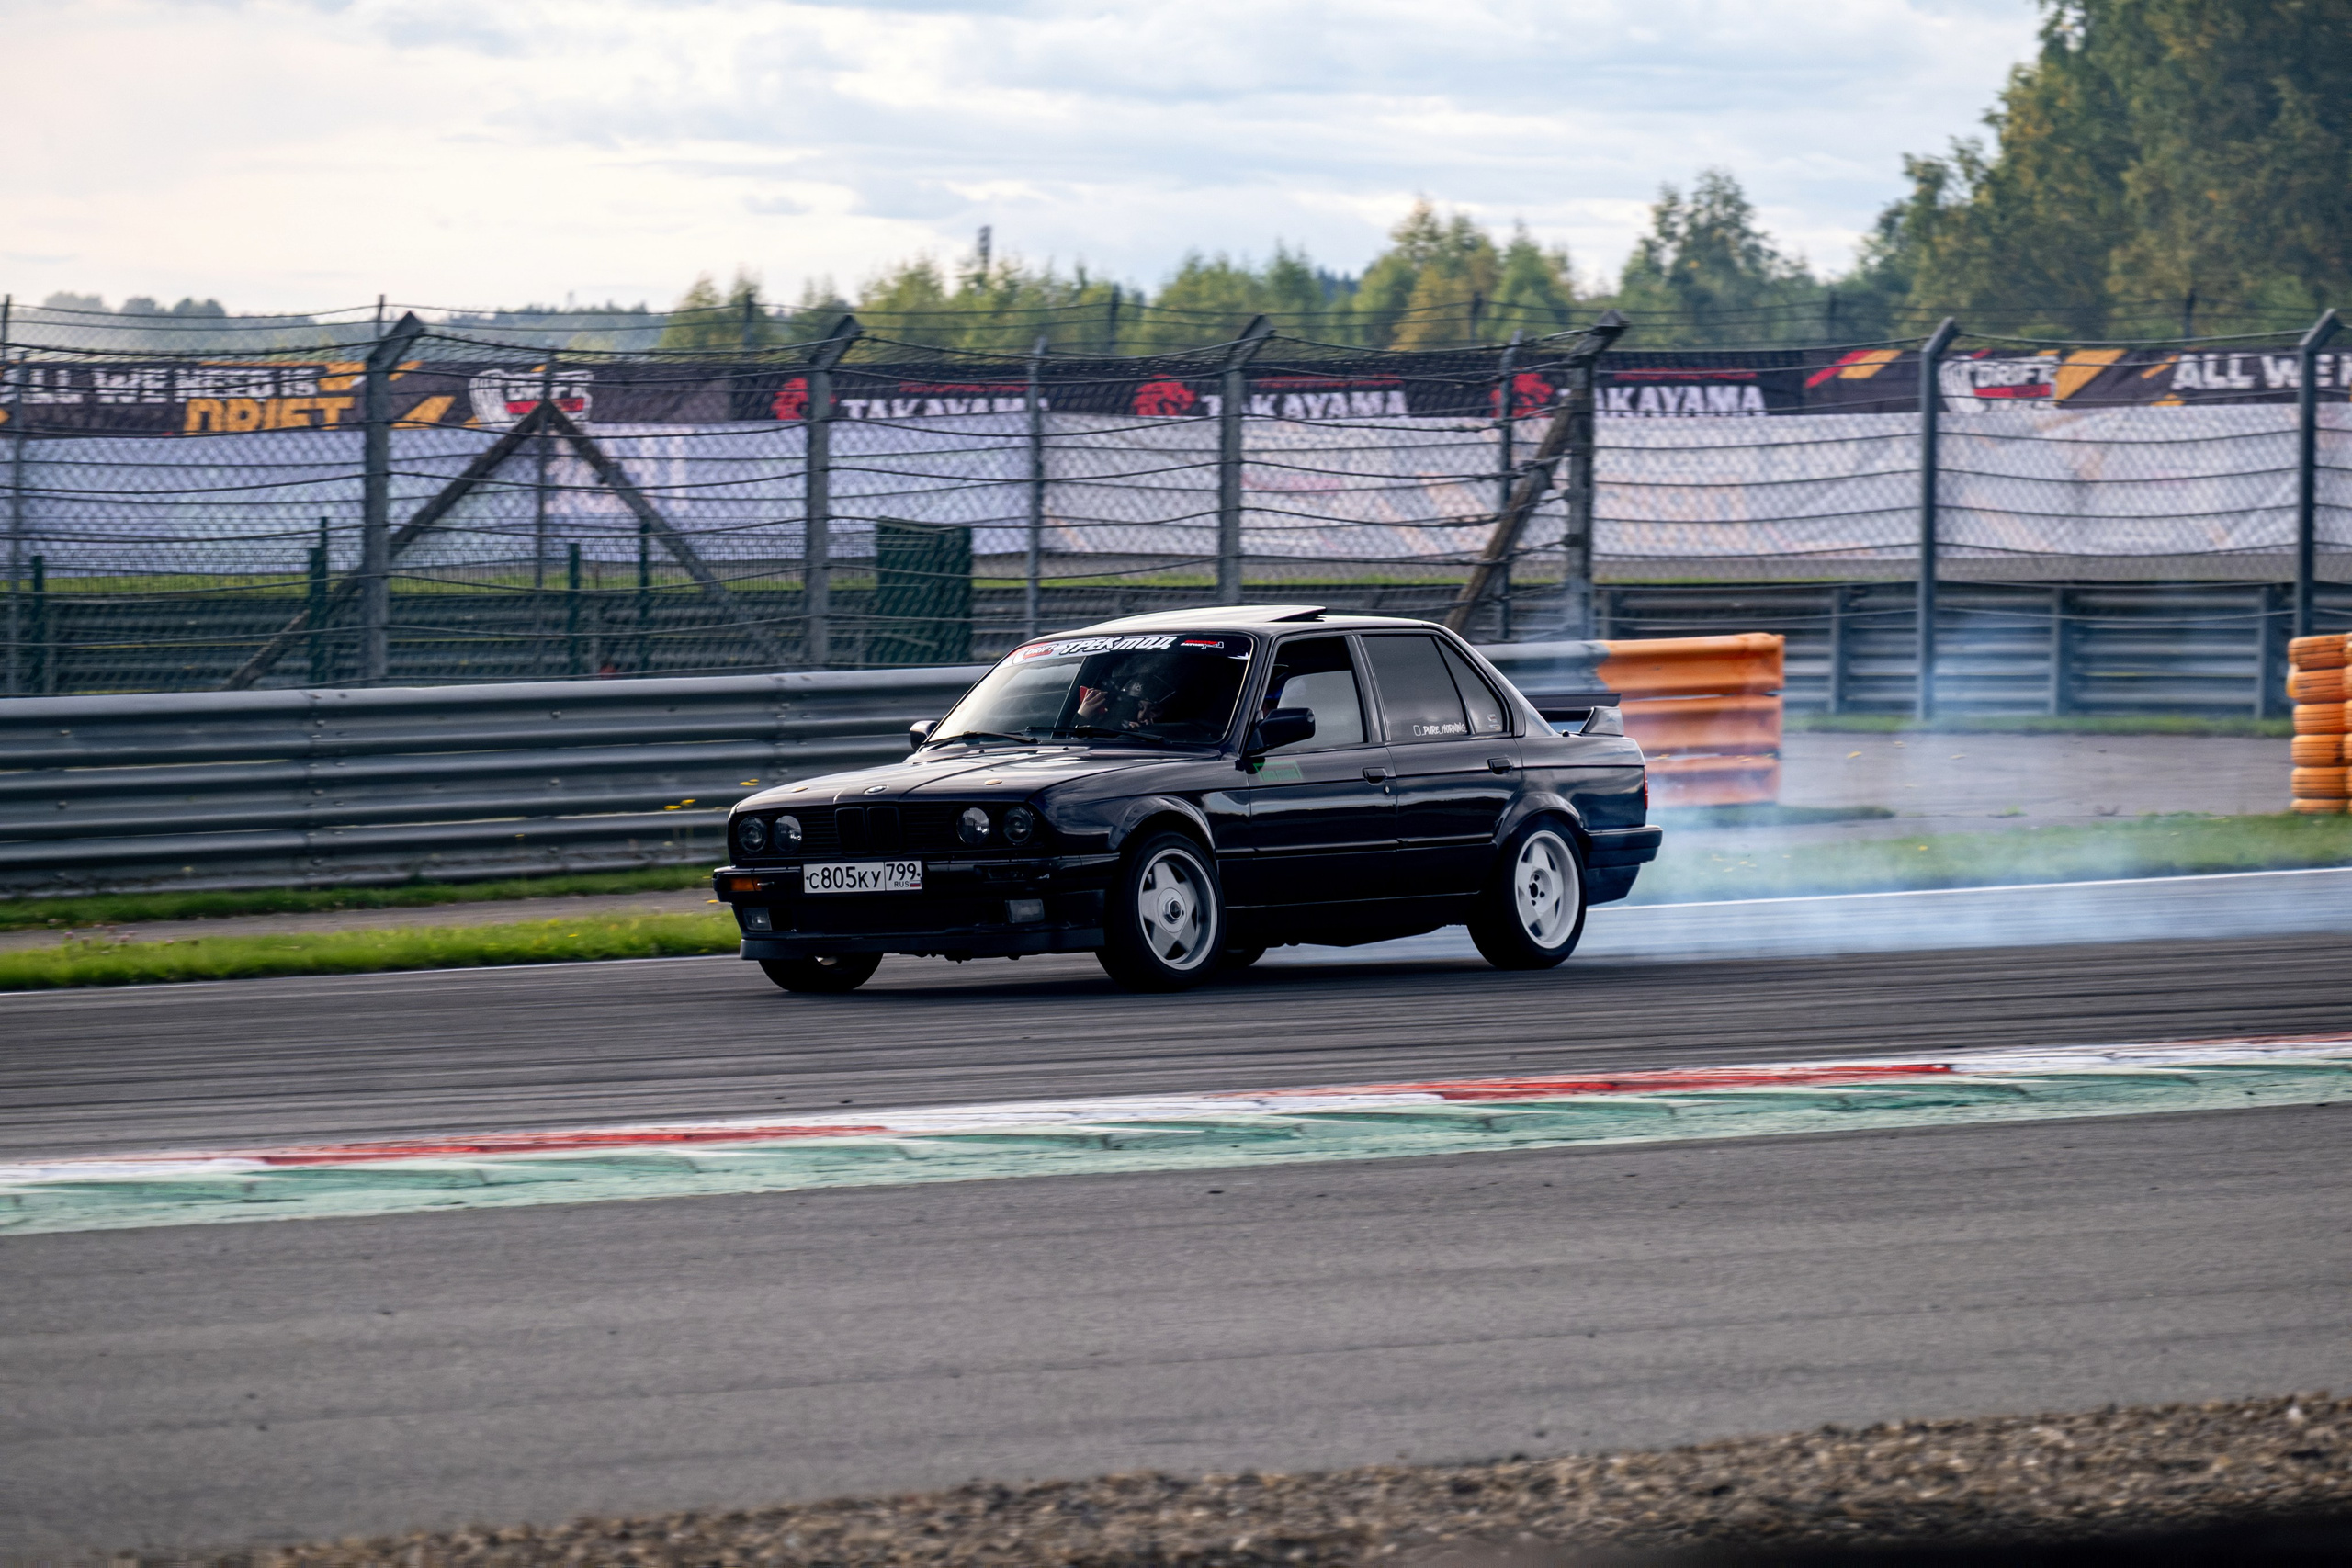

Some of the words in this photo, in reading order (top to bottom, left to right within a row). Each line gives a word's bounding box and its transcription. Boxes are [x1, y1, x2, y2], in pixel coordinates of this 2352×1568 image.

[2171, 353, 2256, 390] ALL
[2261, 353, 2335, 389] WE
[1200, 390, 1409, 418] TKAYAMA
[886, 863, 917, 881] 799
[894, 880, 910, 888] RUS
